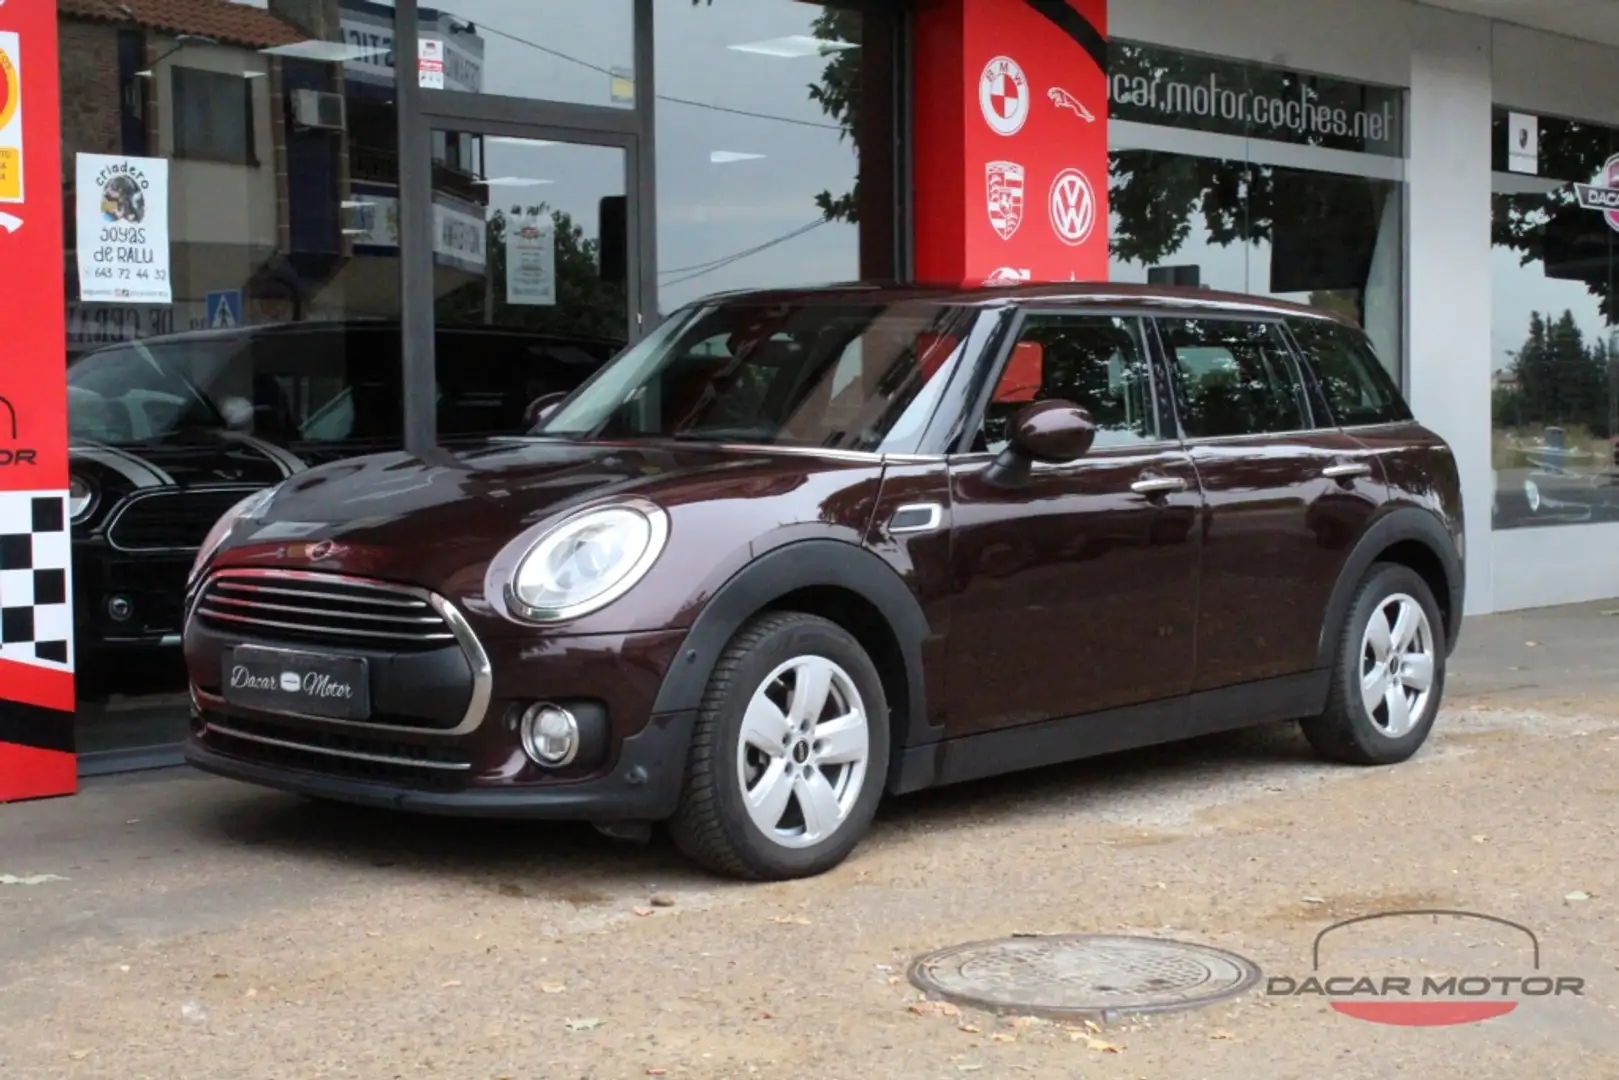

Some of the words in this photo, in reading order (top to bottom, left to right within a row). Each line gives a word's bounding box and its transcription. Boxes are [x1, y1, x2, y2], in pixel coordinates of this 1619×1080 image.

[1108, 73, 1392, 141] car.motor.coches.net
[96, 161, 150, 189] criadero
[94, 246, 113, 262] de
[117, 246, 153, 263] RALU
[118, 268, 131, 280] 72
[136, 268, 149, 280] 44
[230, 665, 278, 690] Dacar
[303, 671, 353, 699] Motor
